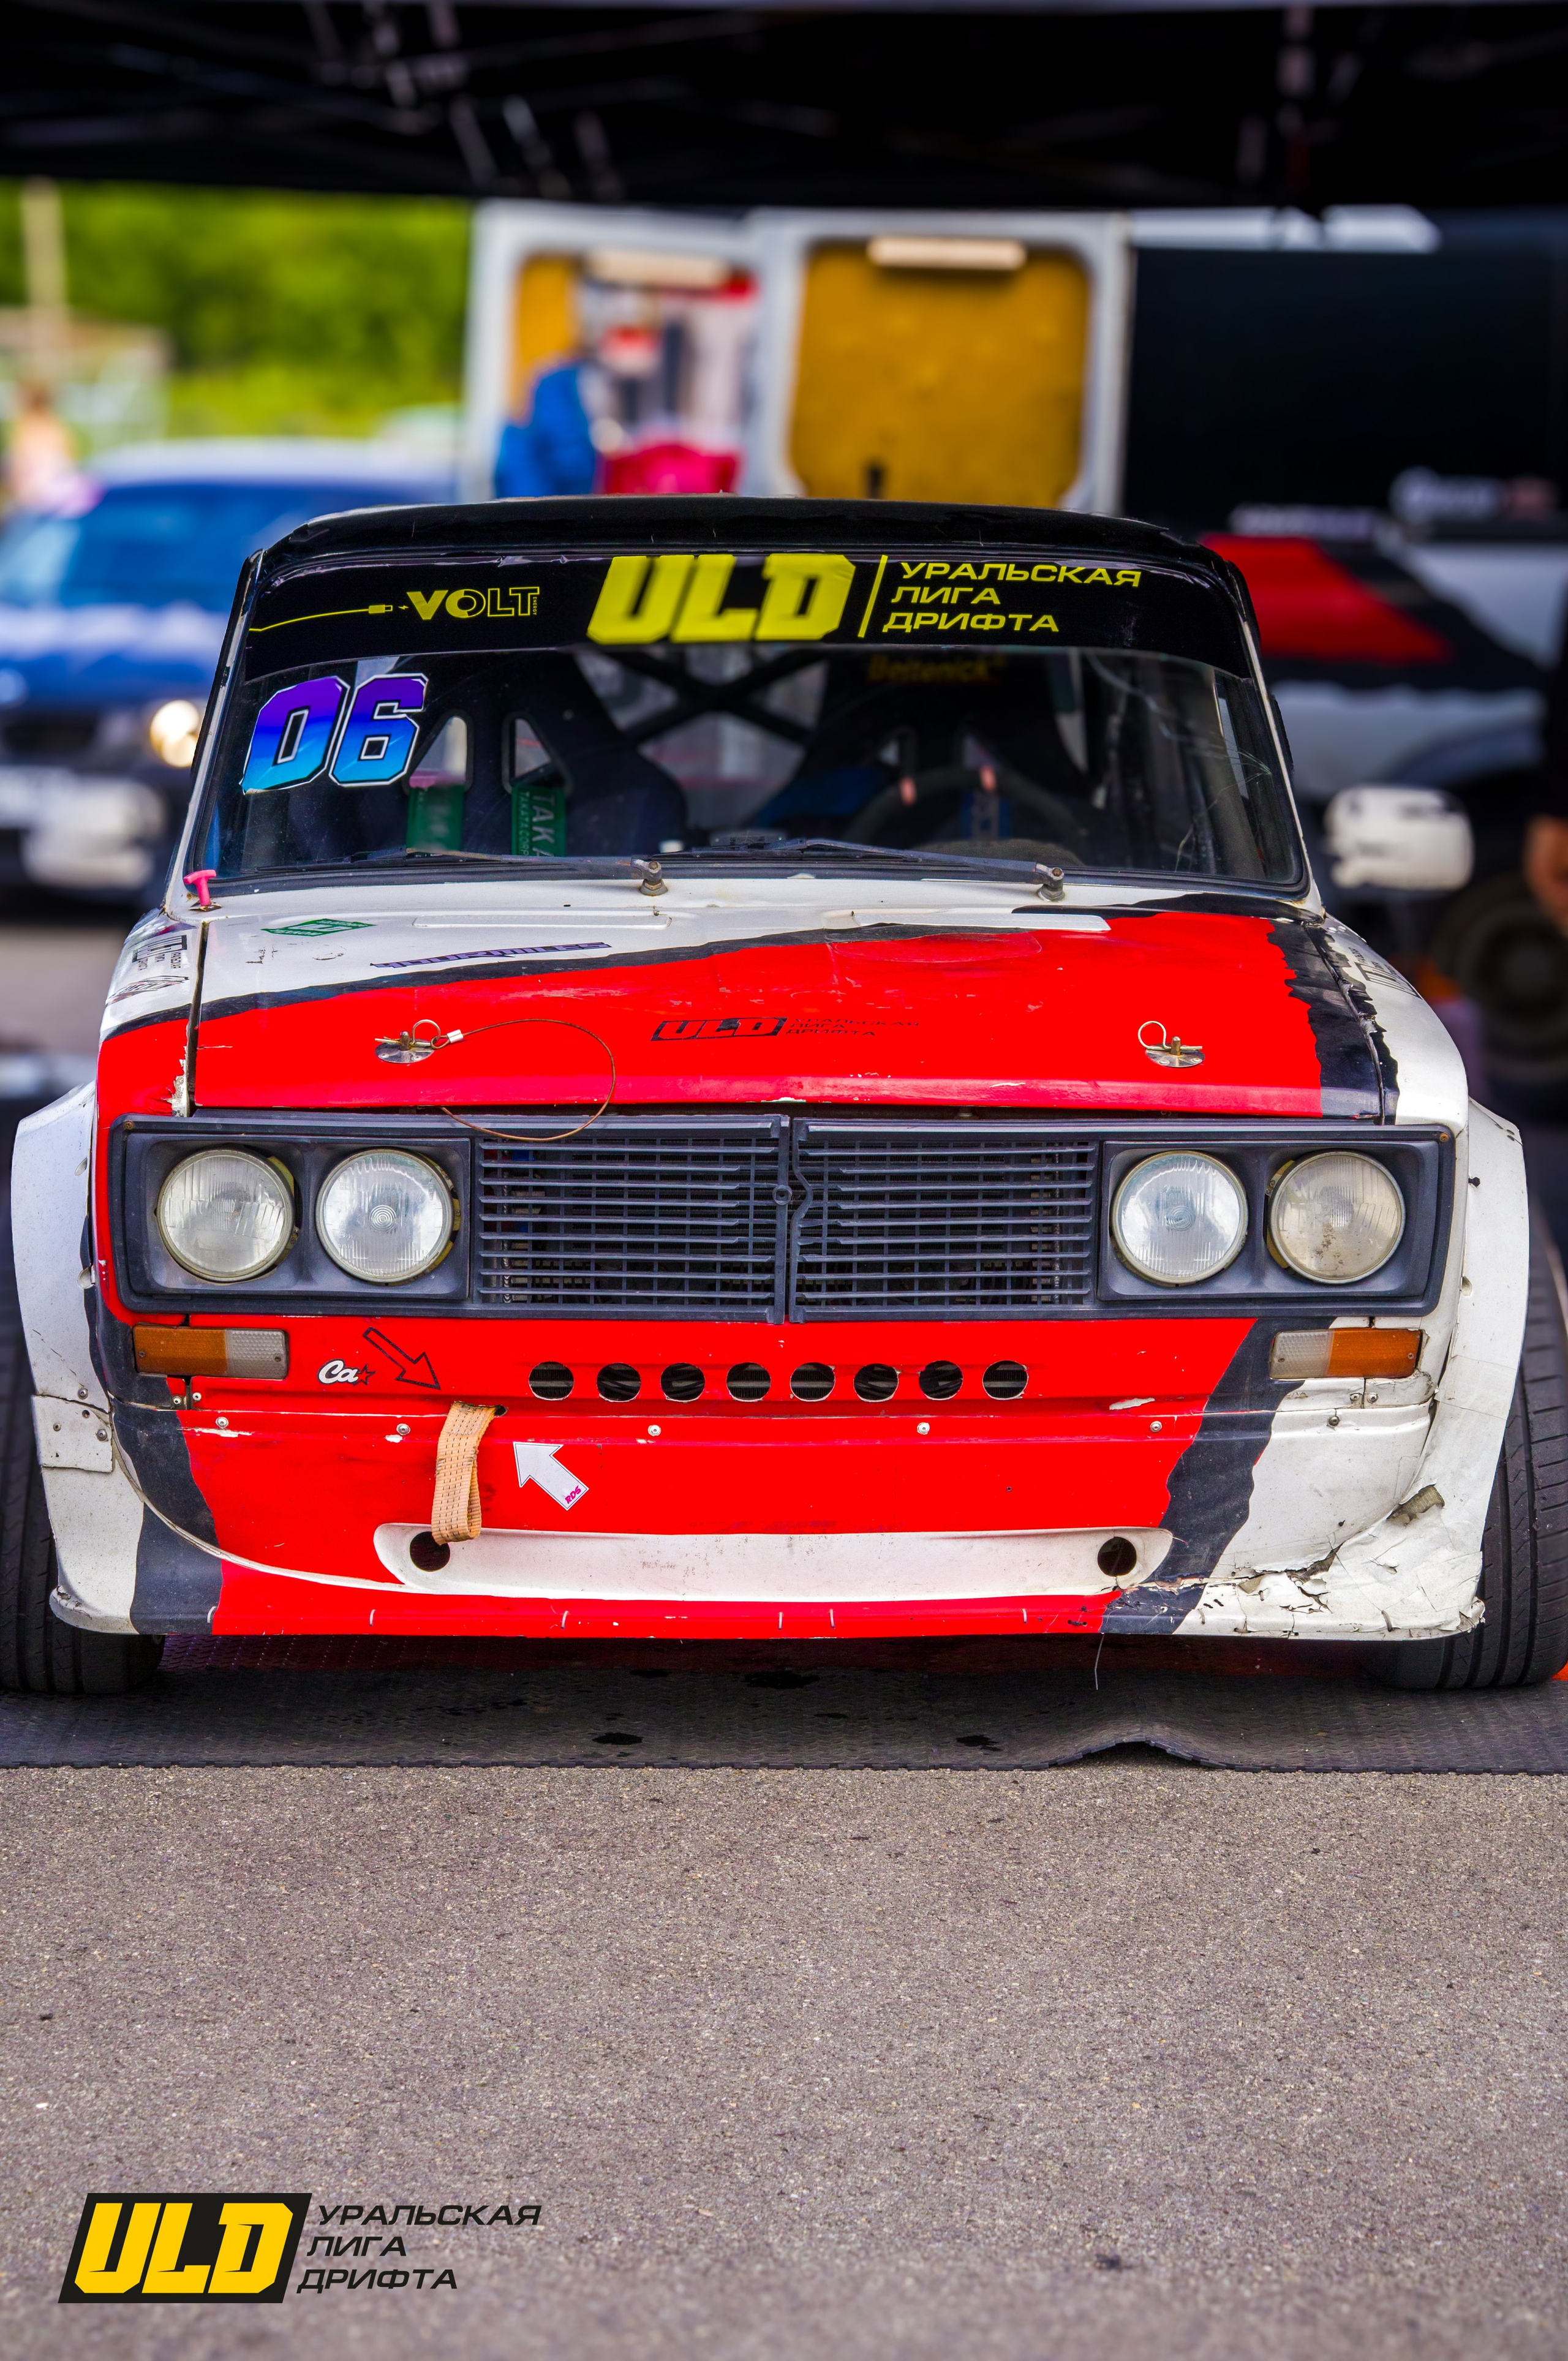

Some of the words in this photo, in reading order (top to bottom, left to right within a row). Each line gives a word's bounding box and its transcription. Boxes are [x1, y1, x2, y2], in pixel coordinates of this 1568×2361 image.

[900, 562, 1142, 587] УРАЛЬСКАЯ
[406, 586, 540, 620] VOLT
[586, 554, 856, 644] ULD
[891, 586, 1001, 604] ЛИГА
[882, 612, 1060, 633] ДРИФТА
[239, 674, 428, 795] 06
[655, 1018, 782, 1039] ULD
[565, 1485, 582, 1504] RDS
